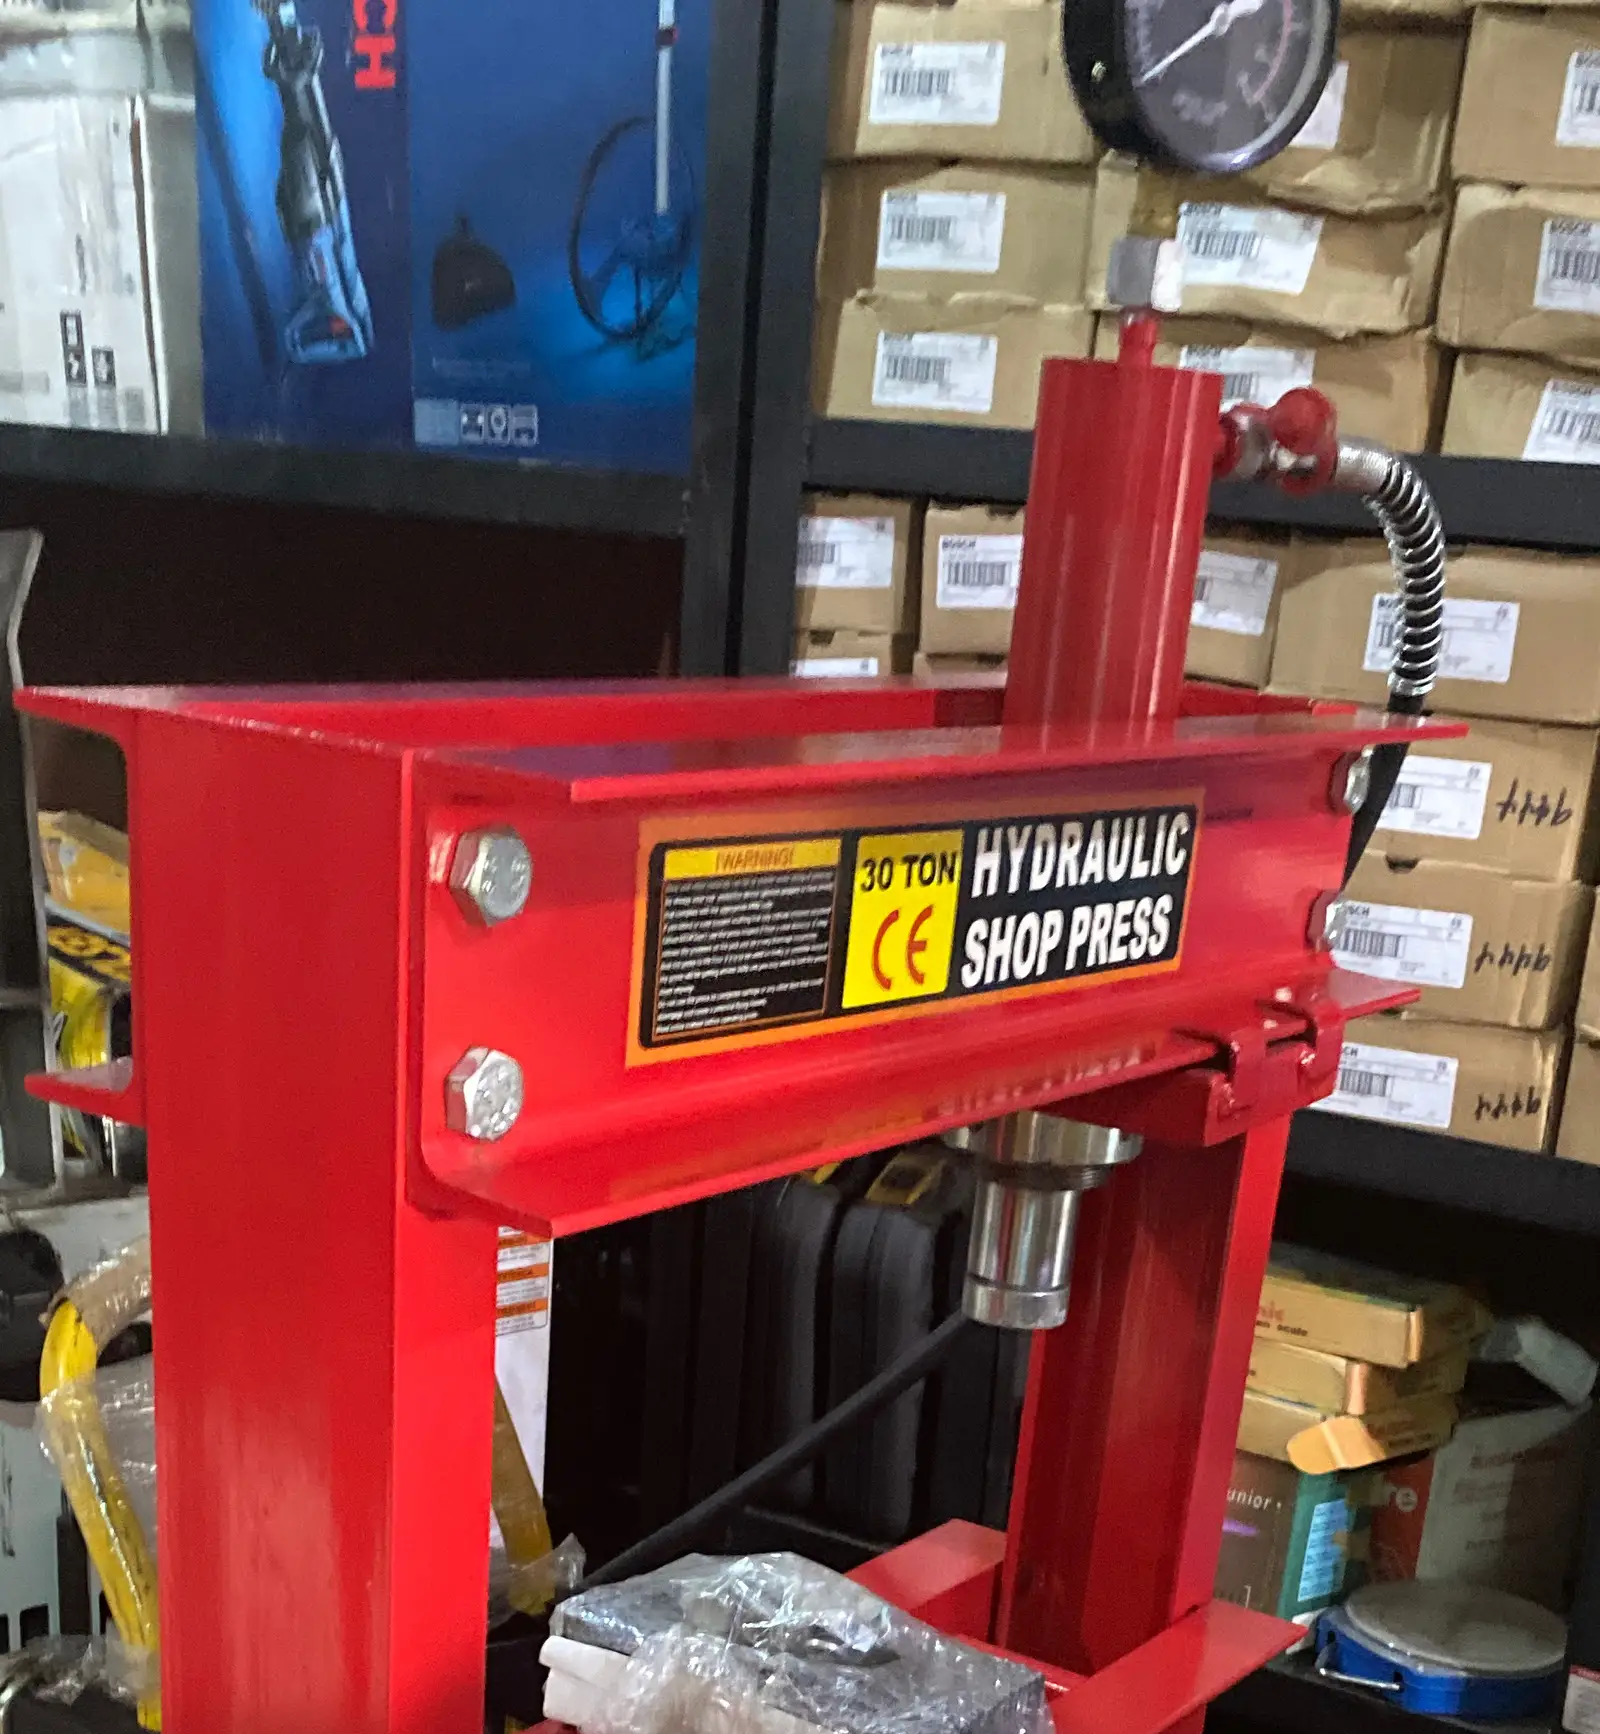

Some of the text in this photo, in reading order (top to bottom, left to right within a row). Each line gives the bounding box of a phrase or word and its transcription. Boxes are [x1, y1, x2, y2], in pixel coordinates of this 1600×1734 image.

[859, 850, 957, 893] 30 TON
[971, 811, 1189, 899] HYDRAULIC
[870, 904, 934, 991] CE
[960, 893, 1173, 989] SHOP PRESS
